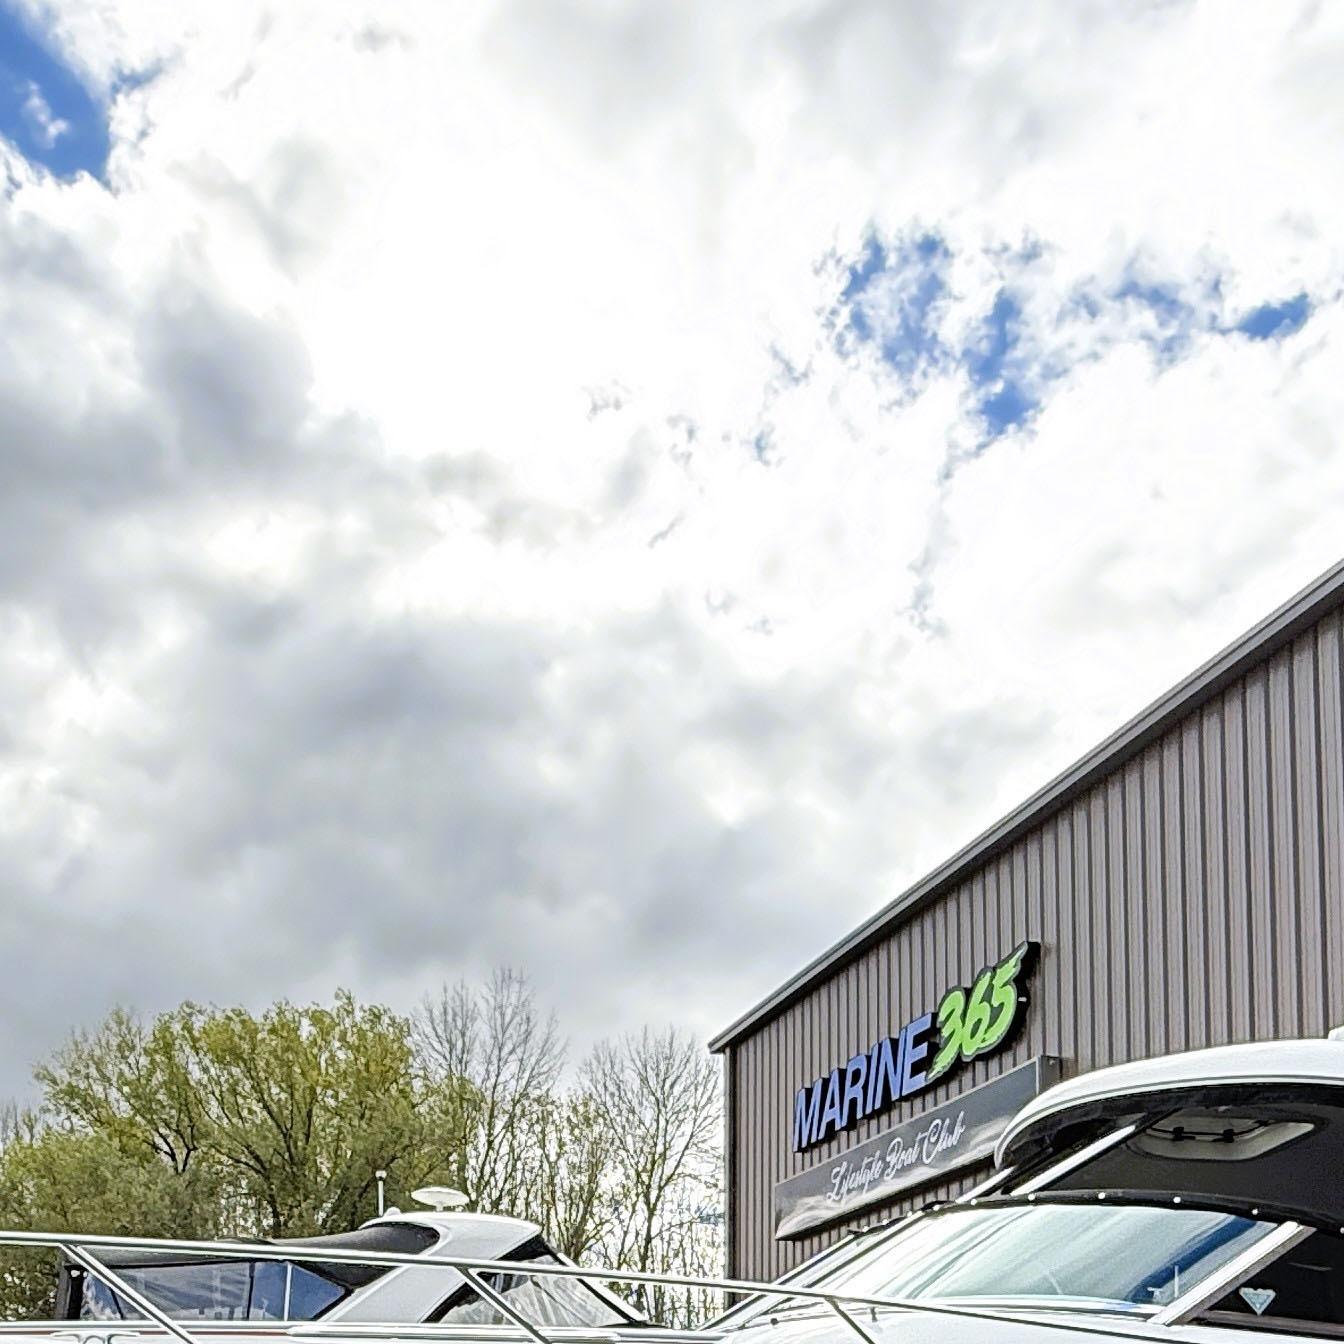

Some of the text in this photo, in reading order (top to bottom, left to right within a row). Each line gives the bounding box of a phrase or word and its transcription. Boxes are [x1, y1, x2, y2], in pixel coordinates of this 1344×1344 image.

[792, 941, 1029, 1153] MARINE 365
[884, 1136, 928, 1181] Boat
[922, 1110, 966, 1165] Club
